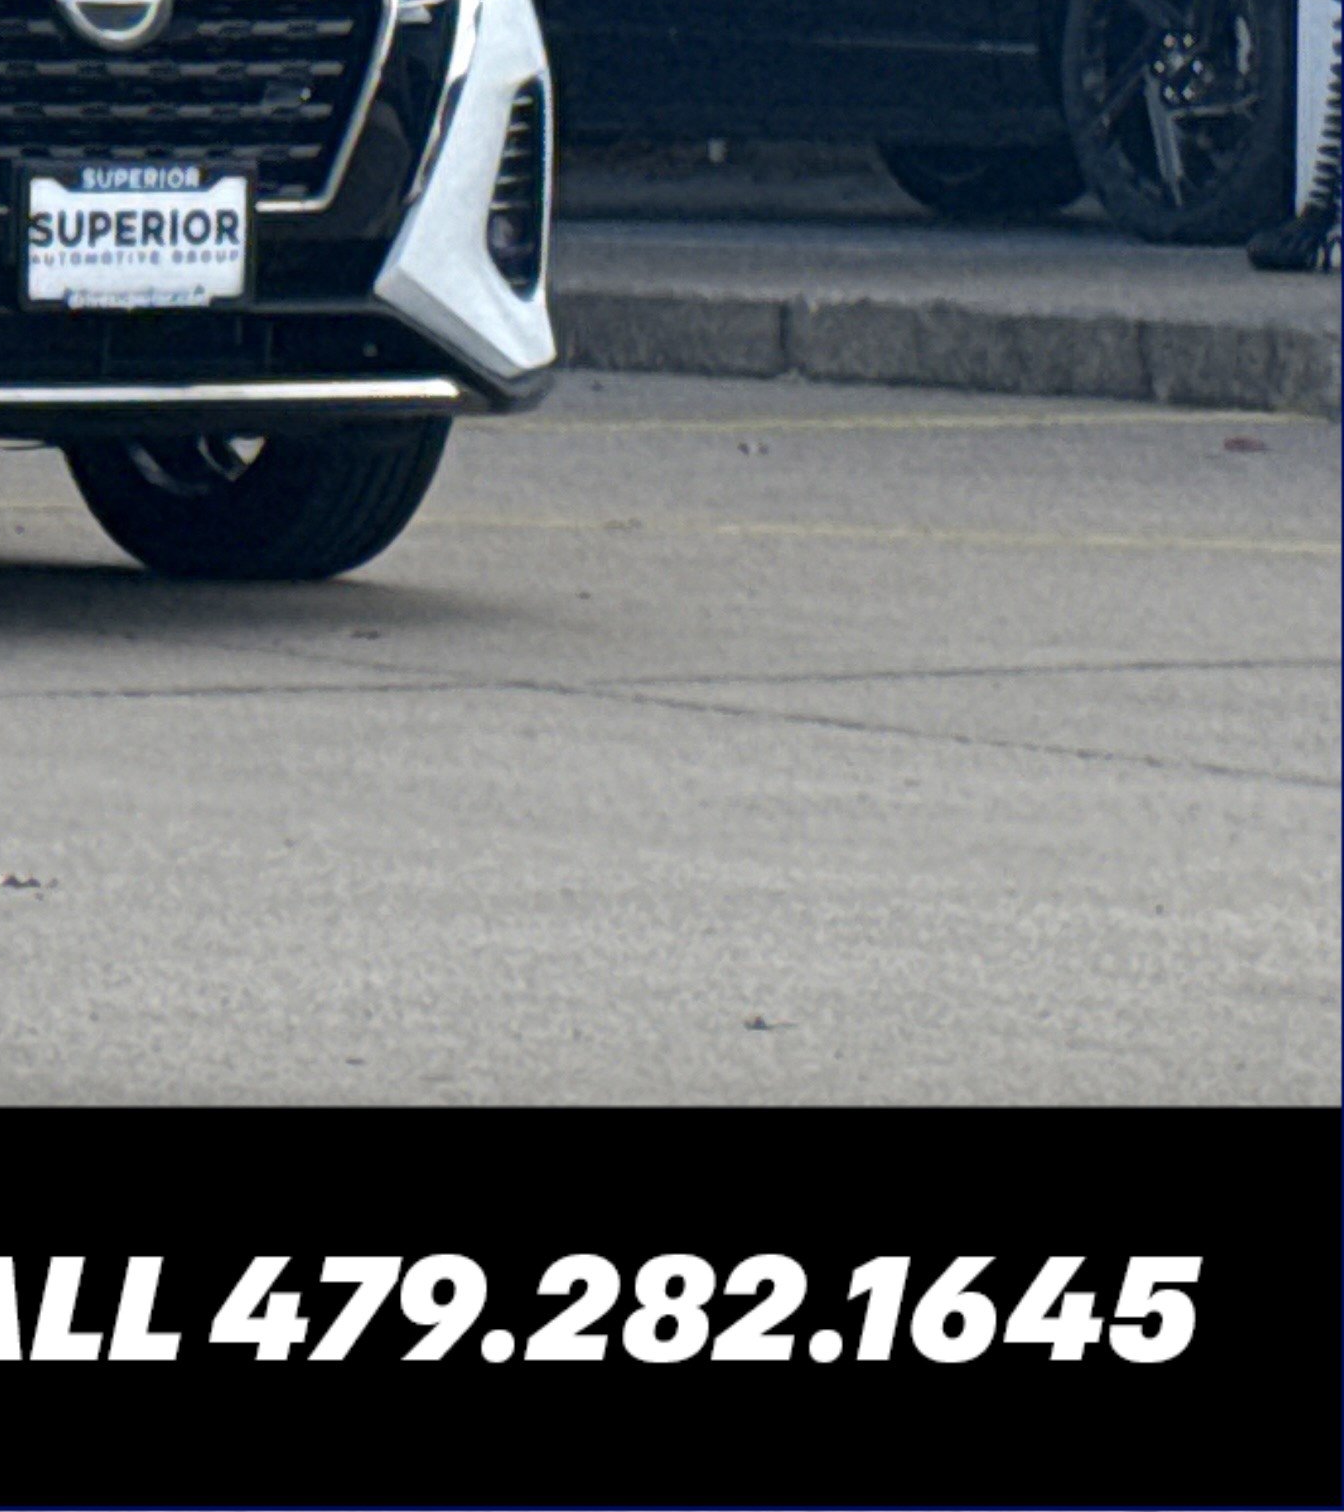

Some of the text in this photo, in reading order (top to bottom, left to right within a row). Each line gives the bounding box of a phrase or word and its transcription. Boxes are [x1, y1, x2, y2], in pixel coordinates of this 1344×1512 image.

[82, 167, 200, 189] SUPERIOR
[29, 208, 240, 248] SUPERIOR
[31, 249, 239, 266] AUTOMOTIVE GROUP
